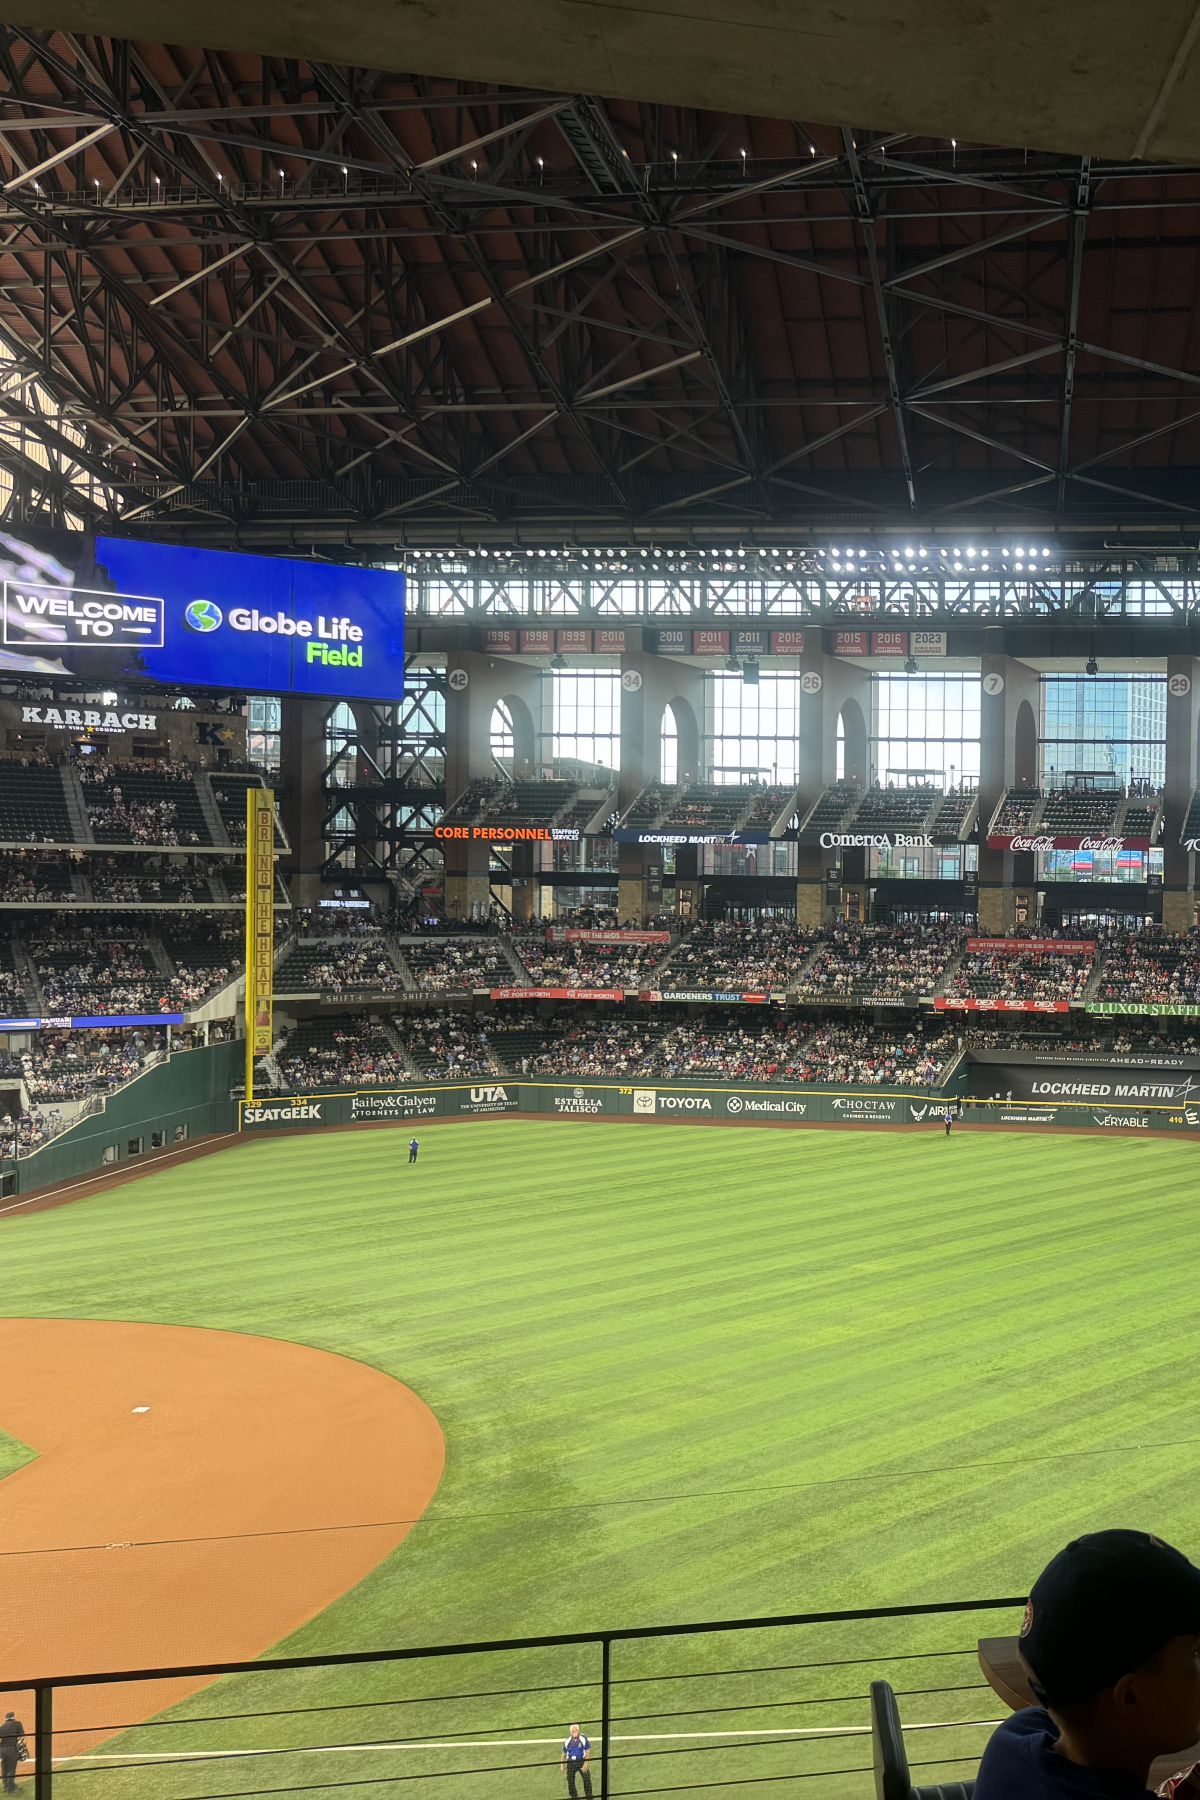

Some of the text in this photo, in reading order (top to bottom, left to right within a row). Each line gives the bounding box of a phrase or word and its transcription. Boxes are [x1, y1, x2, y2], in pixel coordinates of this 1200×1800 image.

[16, 594, 156, 624] WELCOME
[76, 619, 114, 638] TO
[228, 609, 364, 643] Globe Life
[488, 632, 510, 642] 1996
[526, 632, 548, 642] 1998
[562, 632, 586, 642] 1999
[602, 632, 624, 642] 2010
[660, 632, 682, 642] 2010
[700, 632, 722, 642] 2011
[738, 632, 760, 643] 2011
[778, 633, 802, 643] 2012
[837, 633, 860, 643] 2015
[878, 634, 901, 644] 2016
[915, 634, 942, 644] 2023
[306, 642, 362, 668] Field
[450, 674, 466, 686] 42
[624, 674, 640, 688] 34
[804, 676, 820, 688] 26
[989, 678, 998, 690] 7
[1171, 678, 1188, 691] 29
[22, 706, 156, 730] KARBACH
[197, 722, 225, 746] K
[435, 826, 470, 838] CORE
[473, 827, 552, 840] PERSONNEL
[638, 834, 725, 845] LOCKHEED MARTIN
[894, 834, 934, 848] Bank
[260, 938, 268, 994] HEAT
[664, 991, 712, 1001] GARDENERS
[714, 992, 741, 1001] TRUST
[1099, 1002, 1148, 1015] LUXOR
[470, 1086, 508, 1102] UTA
[1032, 1082, 1175, 1098] LOCKHEED MARTIN
[290, 1098, 308, 1106] 334
[554, 1098, 602, 1108] ESTRELLA
[658, 1098, 712, 1110] TOYOTA
[840, 1098, 896, 1110] CHOCTAW
[244, 1104, 322, 1124] SEATGEEK
[351, 1109, 399, 1120] ATTORNEYS
[558, 1104, 598, 1114] JALISCO
[1168, 1116, 1184, 1124] 410
